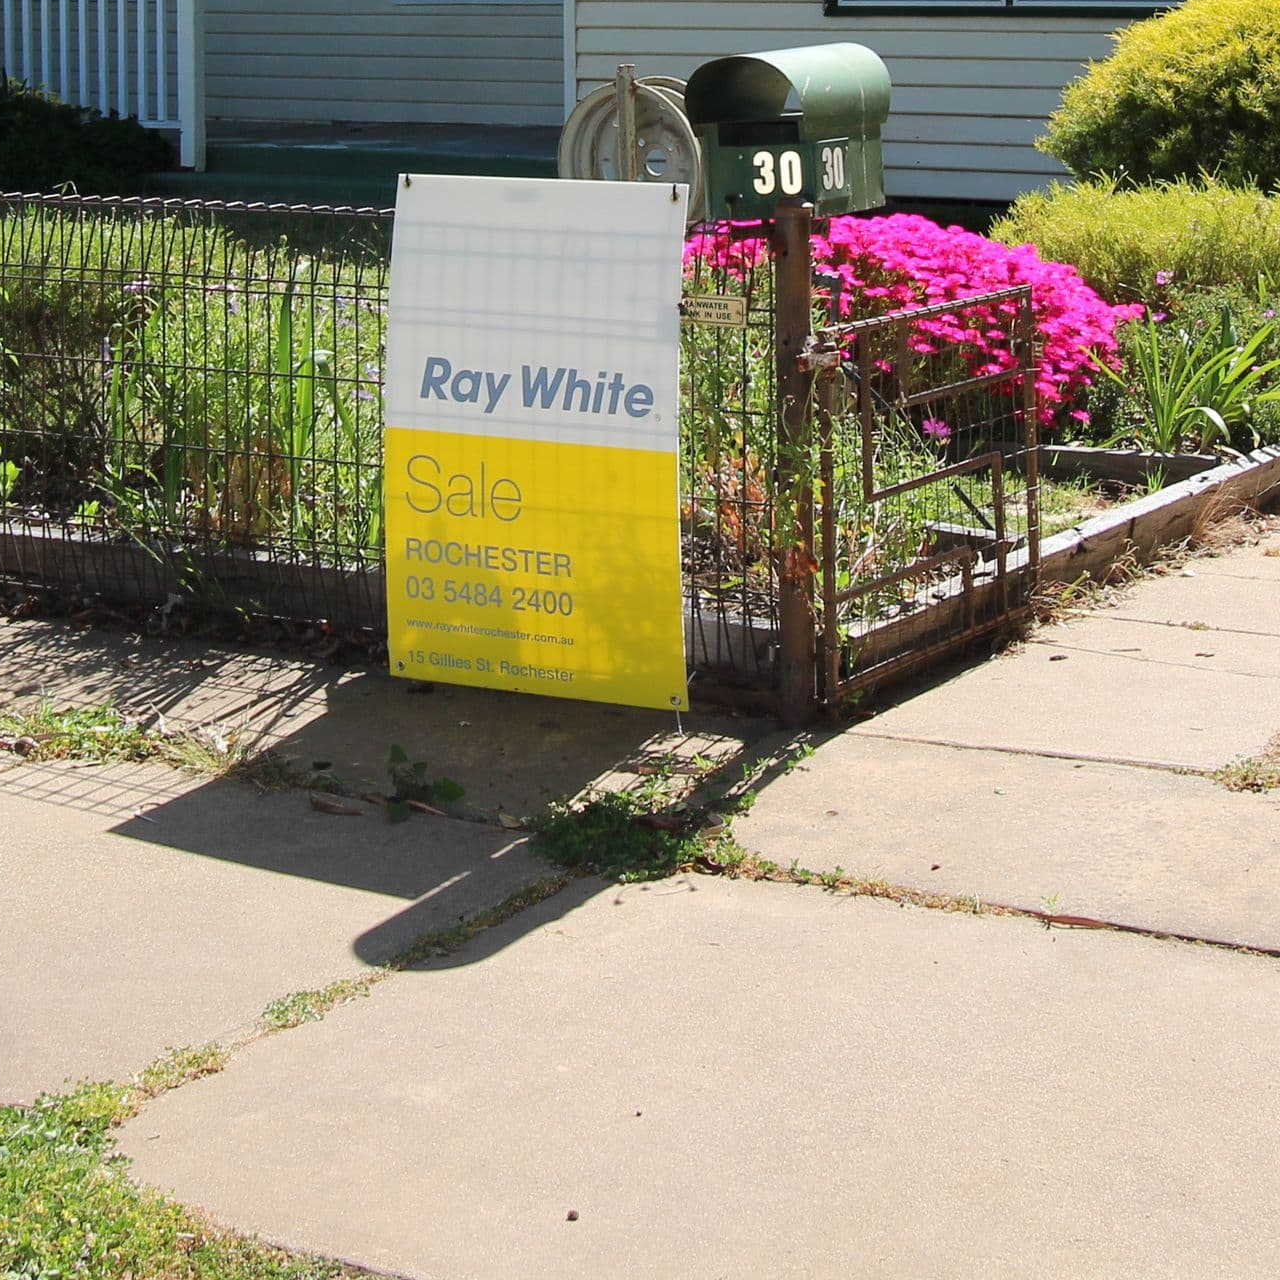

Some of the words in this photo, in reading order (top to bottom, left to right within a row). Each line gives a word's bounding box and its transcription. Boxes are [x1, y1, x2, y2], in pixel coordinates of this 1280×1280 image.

[752, 150, 803, 195] 30
[821, 146, 845, 191] 30
[684, 300, 728, 310] RANWATER
[716, 312, 732, 320] USE
[420, 357, 512, 413] Ray
[521, 365, 654, 418] White
[406, 455, 521, 521] Sale
[406, 537, 572, 577] ROCHESTER
[406, 575, 435, 600] 03
[444, 580, 502, 607] 5484
[512, 587, 573, 616] 2400
[406, 618, 574, 646] www.raywhiterochester.com.au
[407, 650, 425, 664] 15
[429, 652, 471, 670] Gillies
[500, 661, 576, 682] Rochester
